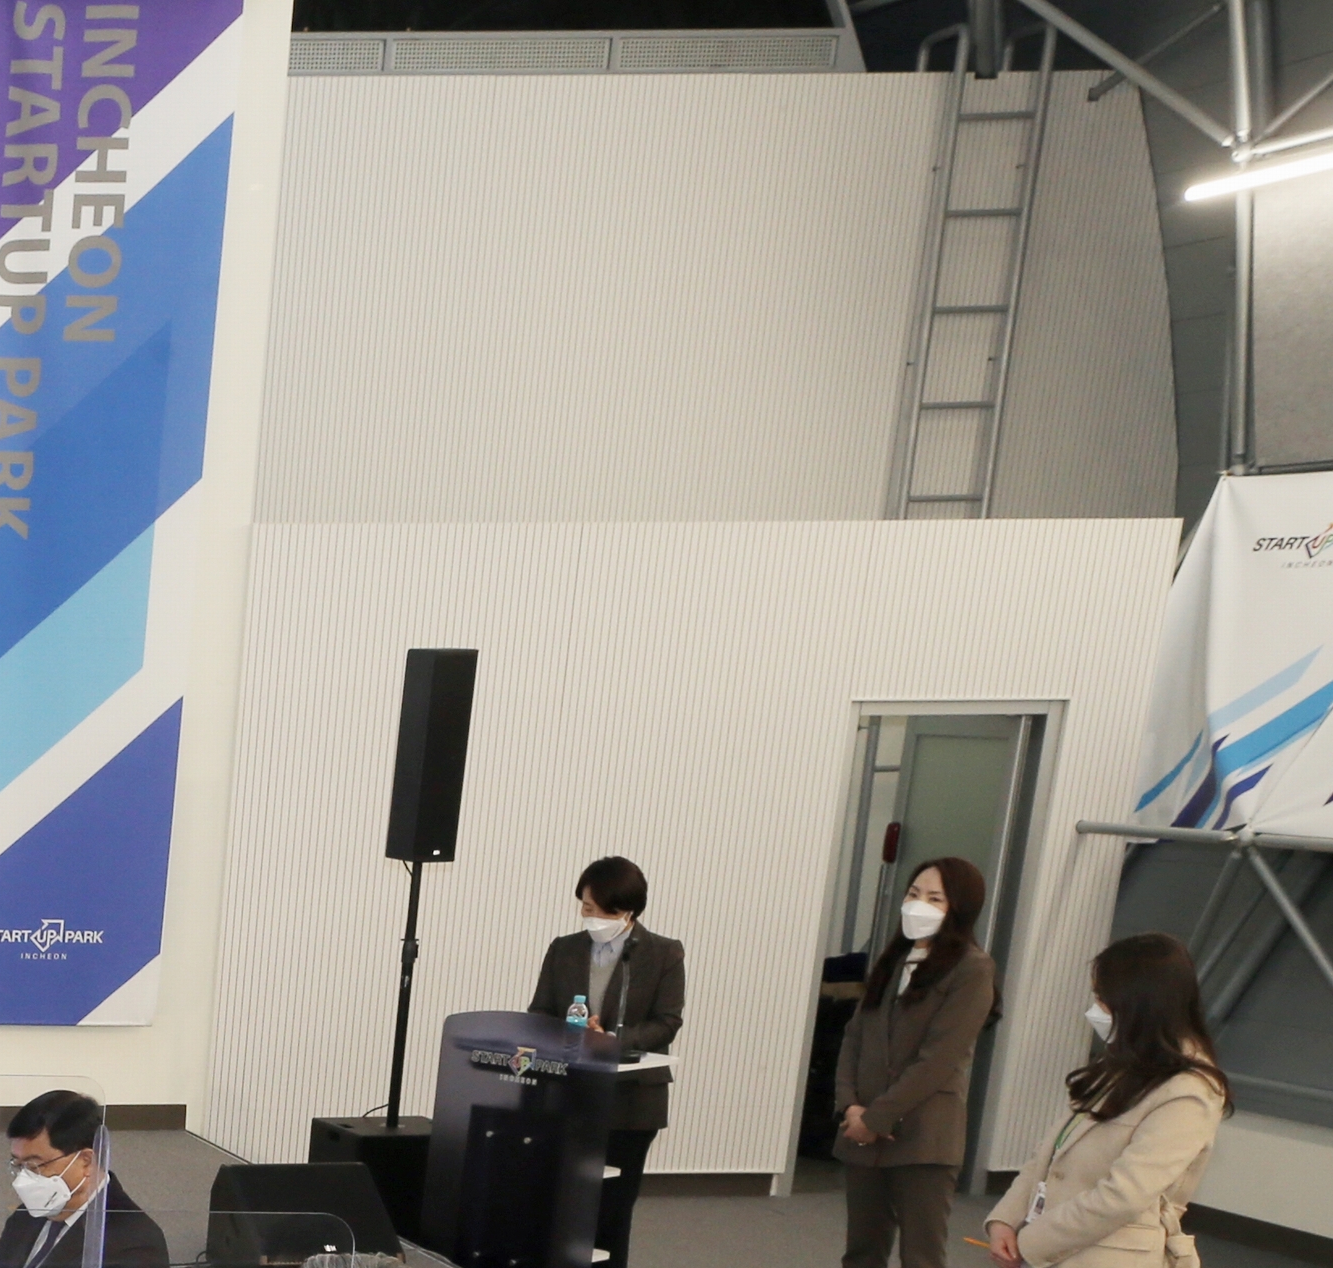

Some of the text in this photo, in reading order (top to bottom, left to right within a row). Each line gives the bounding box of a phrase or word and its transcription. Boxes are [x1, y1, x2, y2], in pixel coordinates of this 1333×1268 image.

[63, 5, 140, 342] INCHEON
[1253, 536, 1310, 552] START
[65, 930, 104, 944] PARK
[20, 952, 68, 961] INCHEON
[471, 1049, 511, 1067] START
[535, 1058, 569, 1076] PARK
